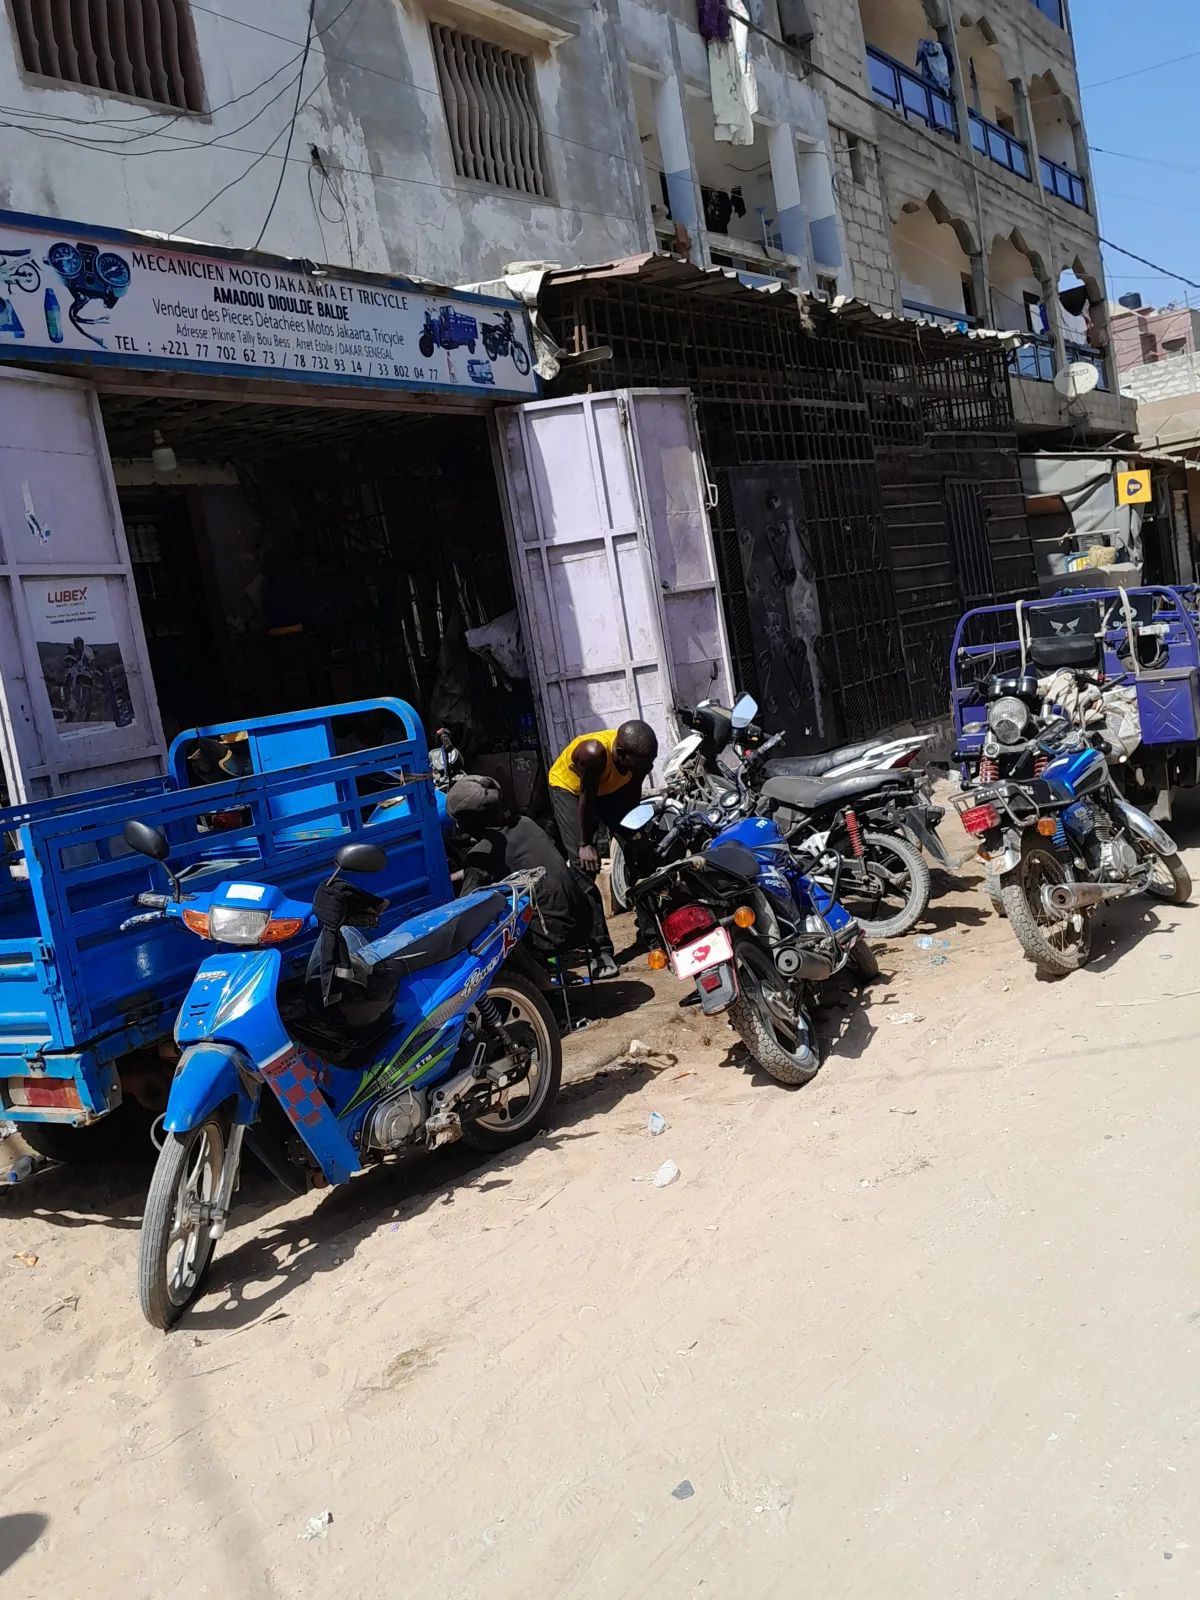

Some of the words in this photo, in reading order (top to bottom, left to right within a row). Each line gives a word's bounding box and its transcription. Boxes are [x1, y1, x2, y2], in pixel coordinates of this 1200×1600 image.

[132, 252, 224, 282] MECANICIEN
[229, 267, 271, 288] MOTO
[340, 286, 354, 303] ET
[356, 289, 410, 311] TRICYCLE
[152, 298, 199, 320] Vendeur
[201, 305, 220, 324] des
[222, 309, 254, 327] Pieces
[256, 311, 306, 333] Détachées
[307, 318, 335, 337] Motos
[336, 322, 373, 343] Jakaarta,
[373, 328, 405, 346] Tricycle
[213, 286, 265, 309] AMADOU
[268, 294, 315, 316] DIOULDE
[317, 300, 350, 322] BALDE
[114, 335, 139, 352] TEL
[161, 341, 189, 356] +221
[195, 344, 209, 358] 77
[217, 346, 236, 361] 702
[243, 349, 256, 363] 62
[262, 351, 275, 365] 73
[294, 353, 306, 367] 78
[312, 356, 329, 370] 732
[334, 359, 346, 371] 93
[351, 360, 362, 373] 14
[378, 364, 389, 375] 33
[394, 365, 409, 377] 802
[414, 367, 424, 379] 04
[429, 368, 438, 380] 77
[176, 323, 210, 339] Adresse:
[211, 326, 236, 343] Pikine
[238, 329, 255, 347] Tally
[257, 333, 272, 347] Bou
[274, 335, 290, 349] Bess
[296, 337, 314, 351] Arret
[315, 339, 334, 353] Etoile
[339, 344, 363, 357] DAKAR
[363, 346, 394, 361] SENEGAL
[47, 586, 88, 603] LUBEX
[755, 819, 769, 830] TVS
[415, 1053, 433, 1070] KTM
